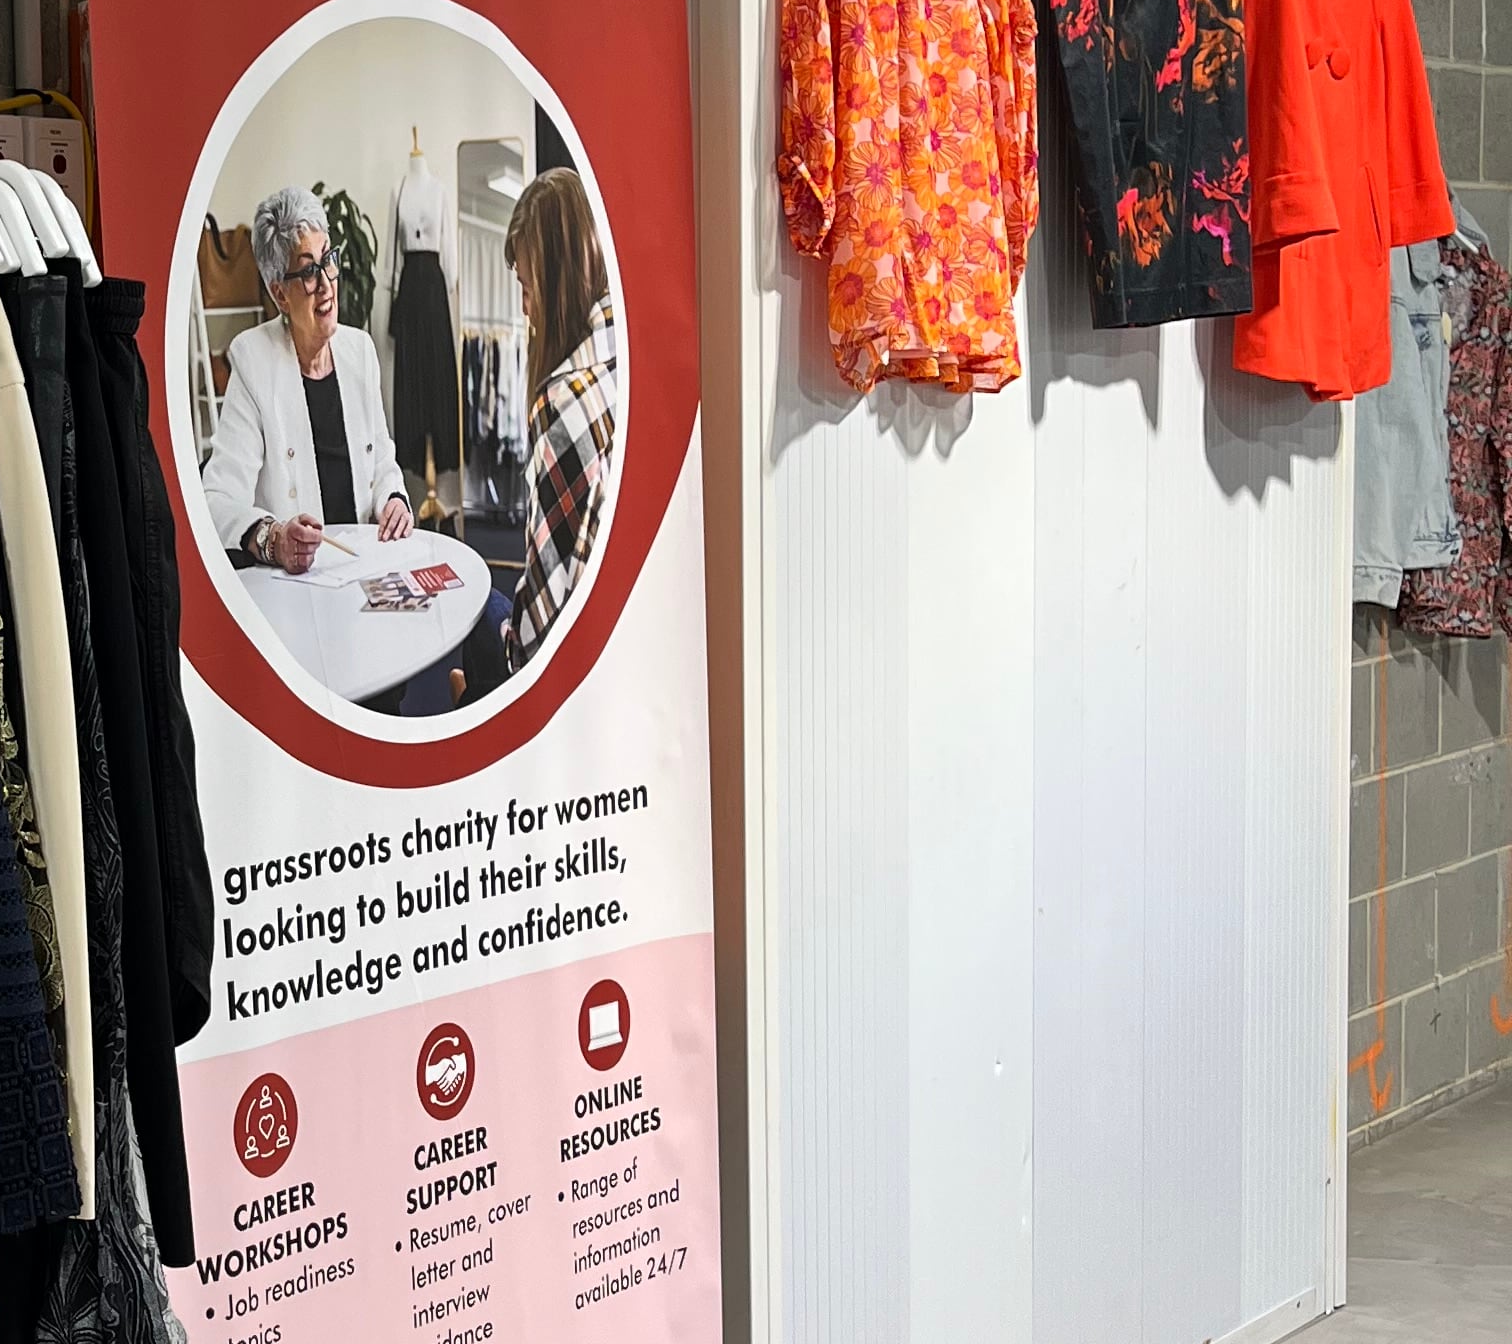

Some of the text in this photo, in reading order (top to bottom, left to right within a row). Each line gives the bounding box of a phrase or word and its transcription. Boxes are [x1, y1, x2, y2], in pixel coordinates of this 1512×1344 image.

[223, 784, 649, 906] grassroots charity for women
[222, 836, 627, 959] looking to build their skills,
[226, 899, 629, 1022] knowledge and confidence.
[574, 1074, 643, 1119] ONLINE
[413, 1126, 488, 1171] CAREER
[559, 1106, 662, 1164] RESOURCES
[233, 1181, 316, 1232] CAREER
[406, 1160, 498, 1215] SUPPORT
[571, 1155, 638, 1204] Range of
[572, 1177, 680, 1239] resources and
[195, 1211, 348, 1286] WORKSHOPS
[409, 1194, 532, 1254] Resume, cover
[573, 1226, 661, 1275] information
[224, 1257, 355, 1321] Job readiness
[411, 1236, 494, 1291] letter and
[575, 1246, 688, 1311] available 24/7
[412, 1284, 491, 1329] interview
